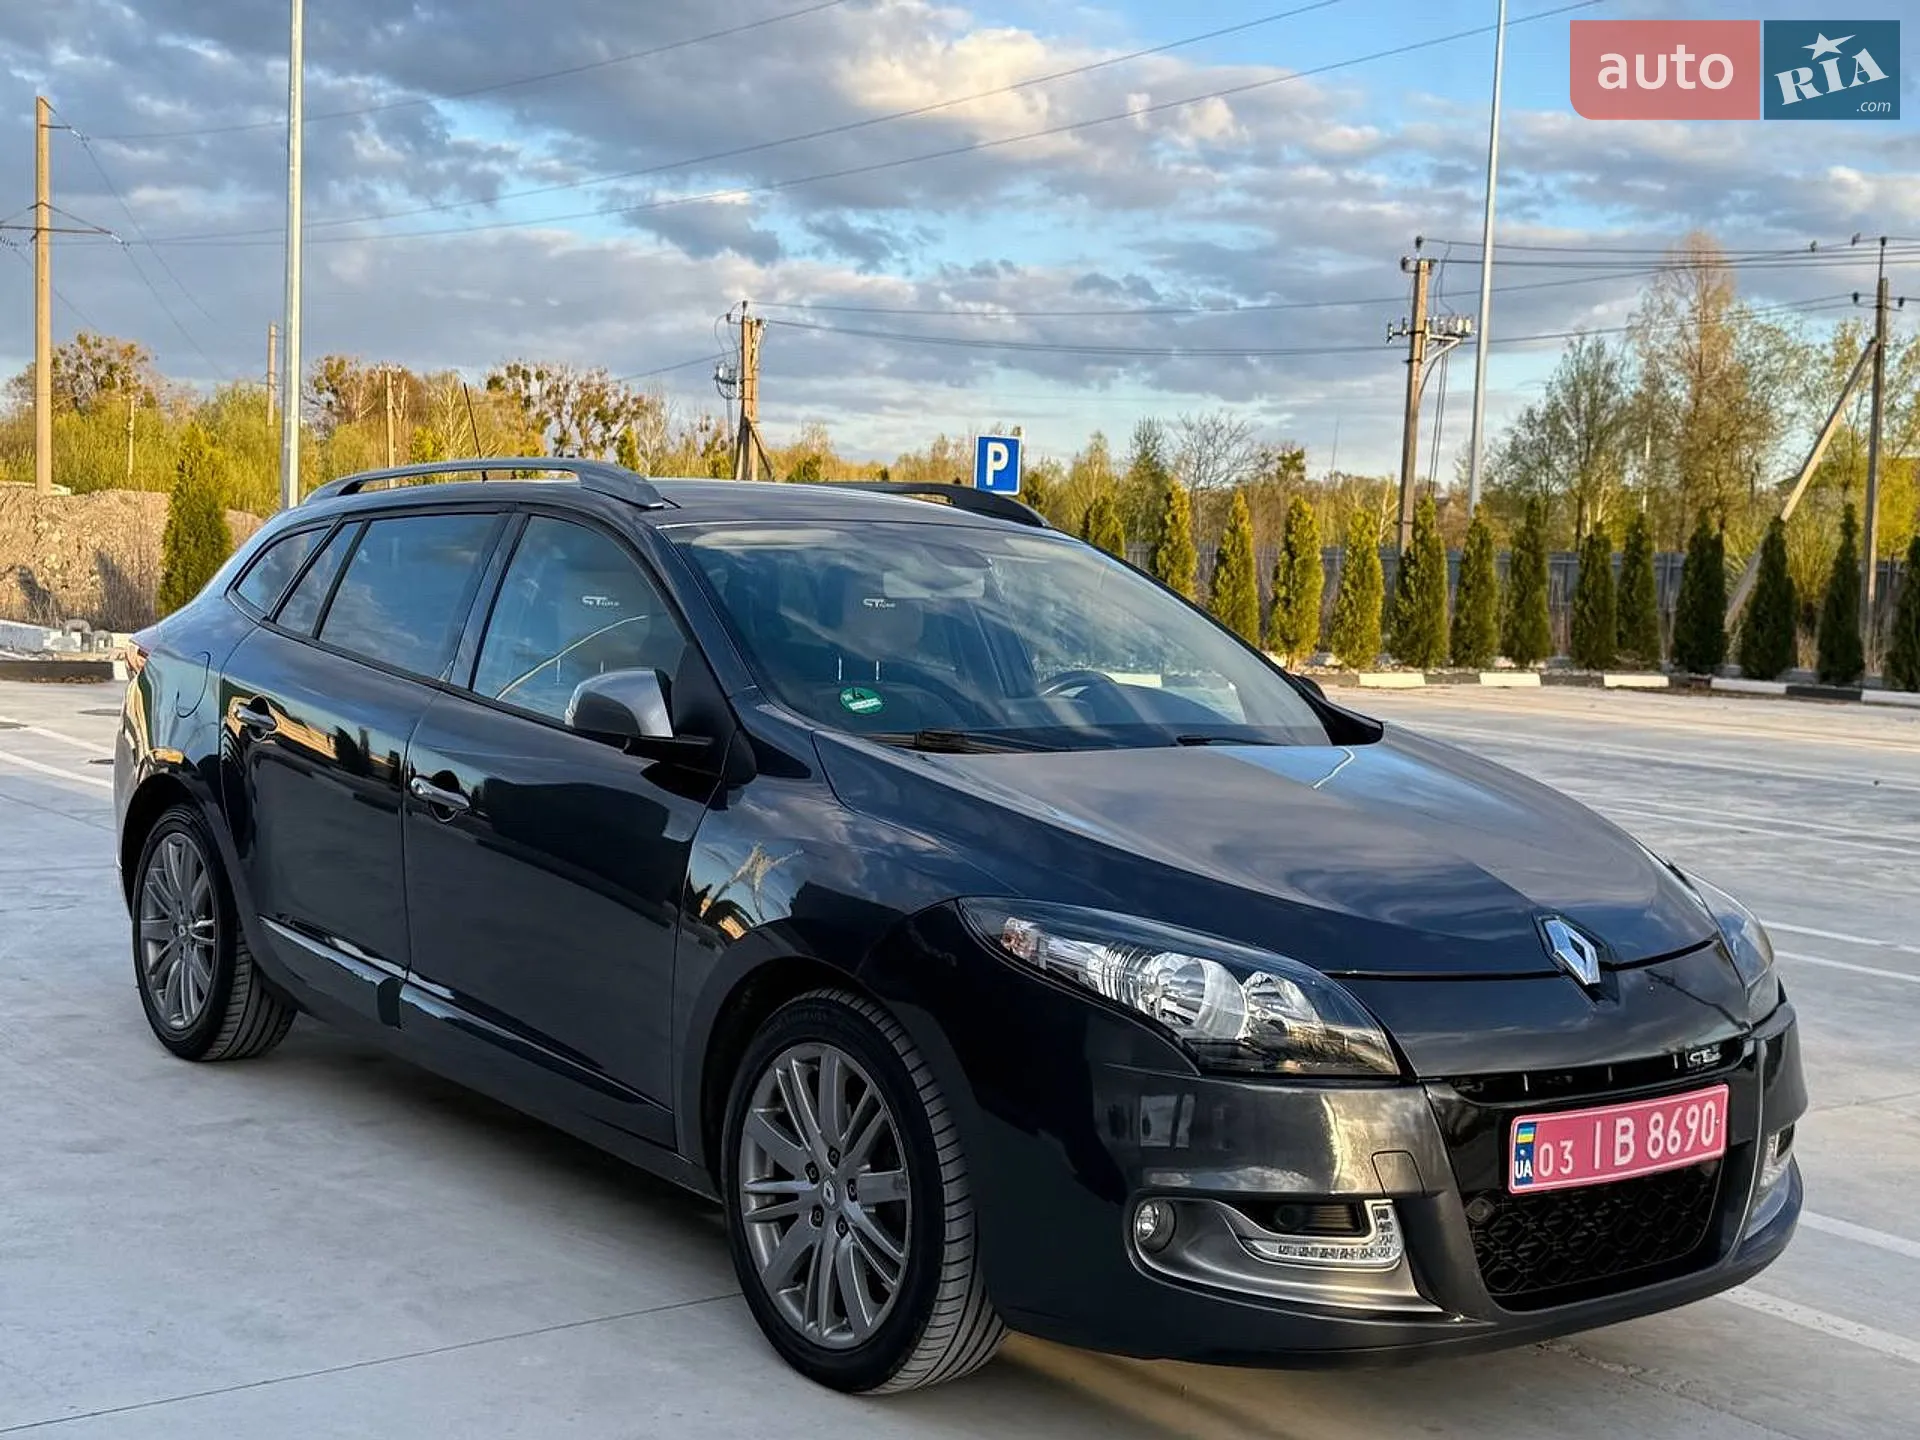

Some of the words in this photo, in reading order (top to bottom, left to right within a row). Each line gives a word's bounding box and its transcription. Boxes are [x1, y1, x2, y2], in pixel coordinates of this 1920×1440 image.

[985, 441, 1009, 486] P
[1538, 1139, 1574, 1178] 03
[1593, 1116, 1636, 1170] IB
[1646, 1100, 1717, 1160] 8690
[1514, 1159, 1534, 1179] UA
